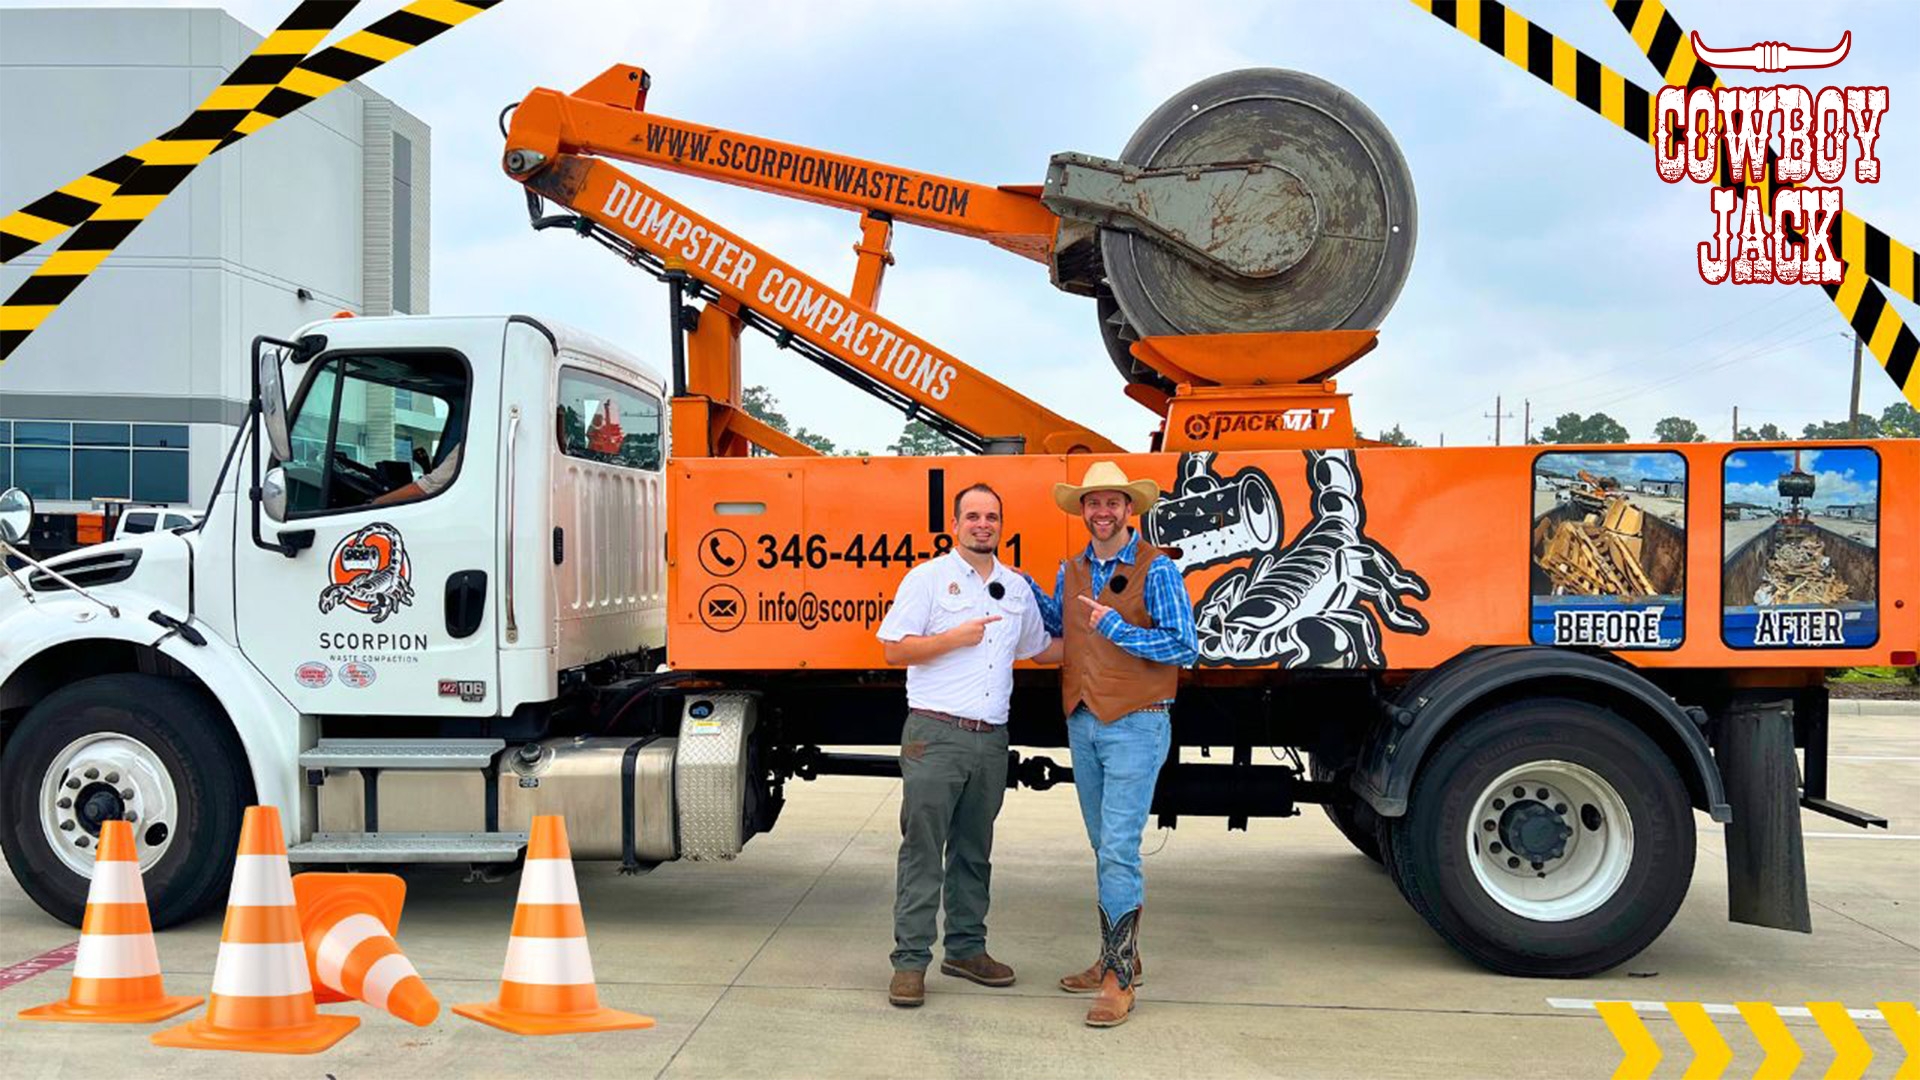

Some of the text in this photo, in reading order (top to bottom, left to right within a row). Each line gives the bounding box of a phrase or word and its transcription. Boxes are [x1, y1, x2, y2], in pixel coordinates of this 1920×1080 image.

[647, 123, 970, 217] WWW.SCORPIONWASTE.COM
[601, 179, 958, 401] DUMPSTER COMPACTIONS
[757, 533, 1020, 569] 346-444-81
[319, 632, 428, 651] SCORPION
[1554, 611, 1660, 646] BEFORE
[1755, 609, 1843, 645] AFTER
[329, 654, 419, 664] WASTE COMPACTION
[459, 681, 484, 696] 106
